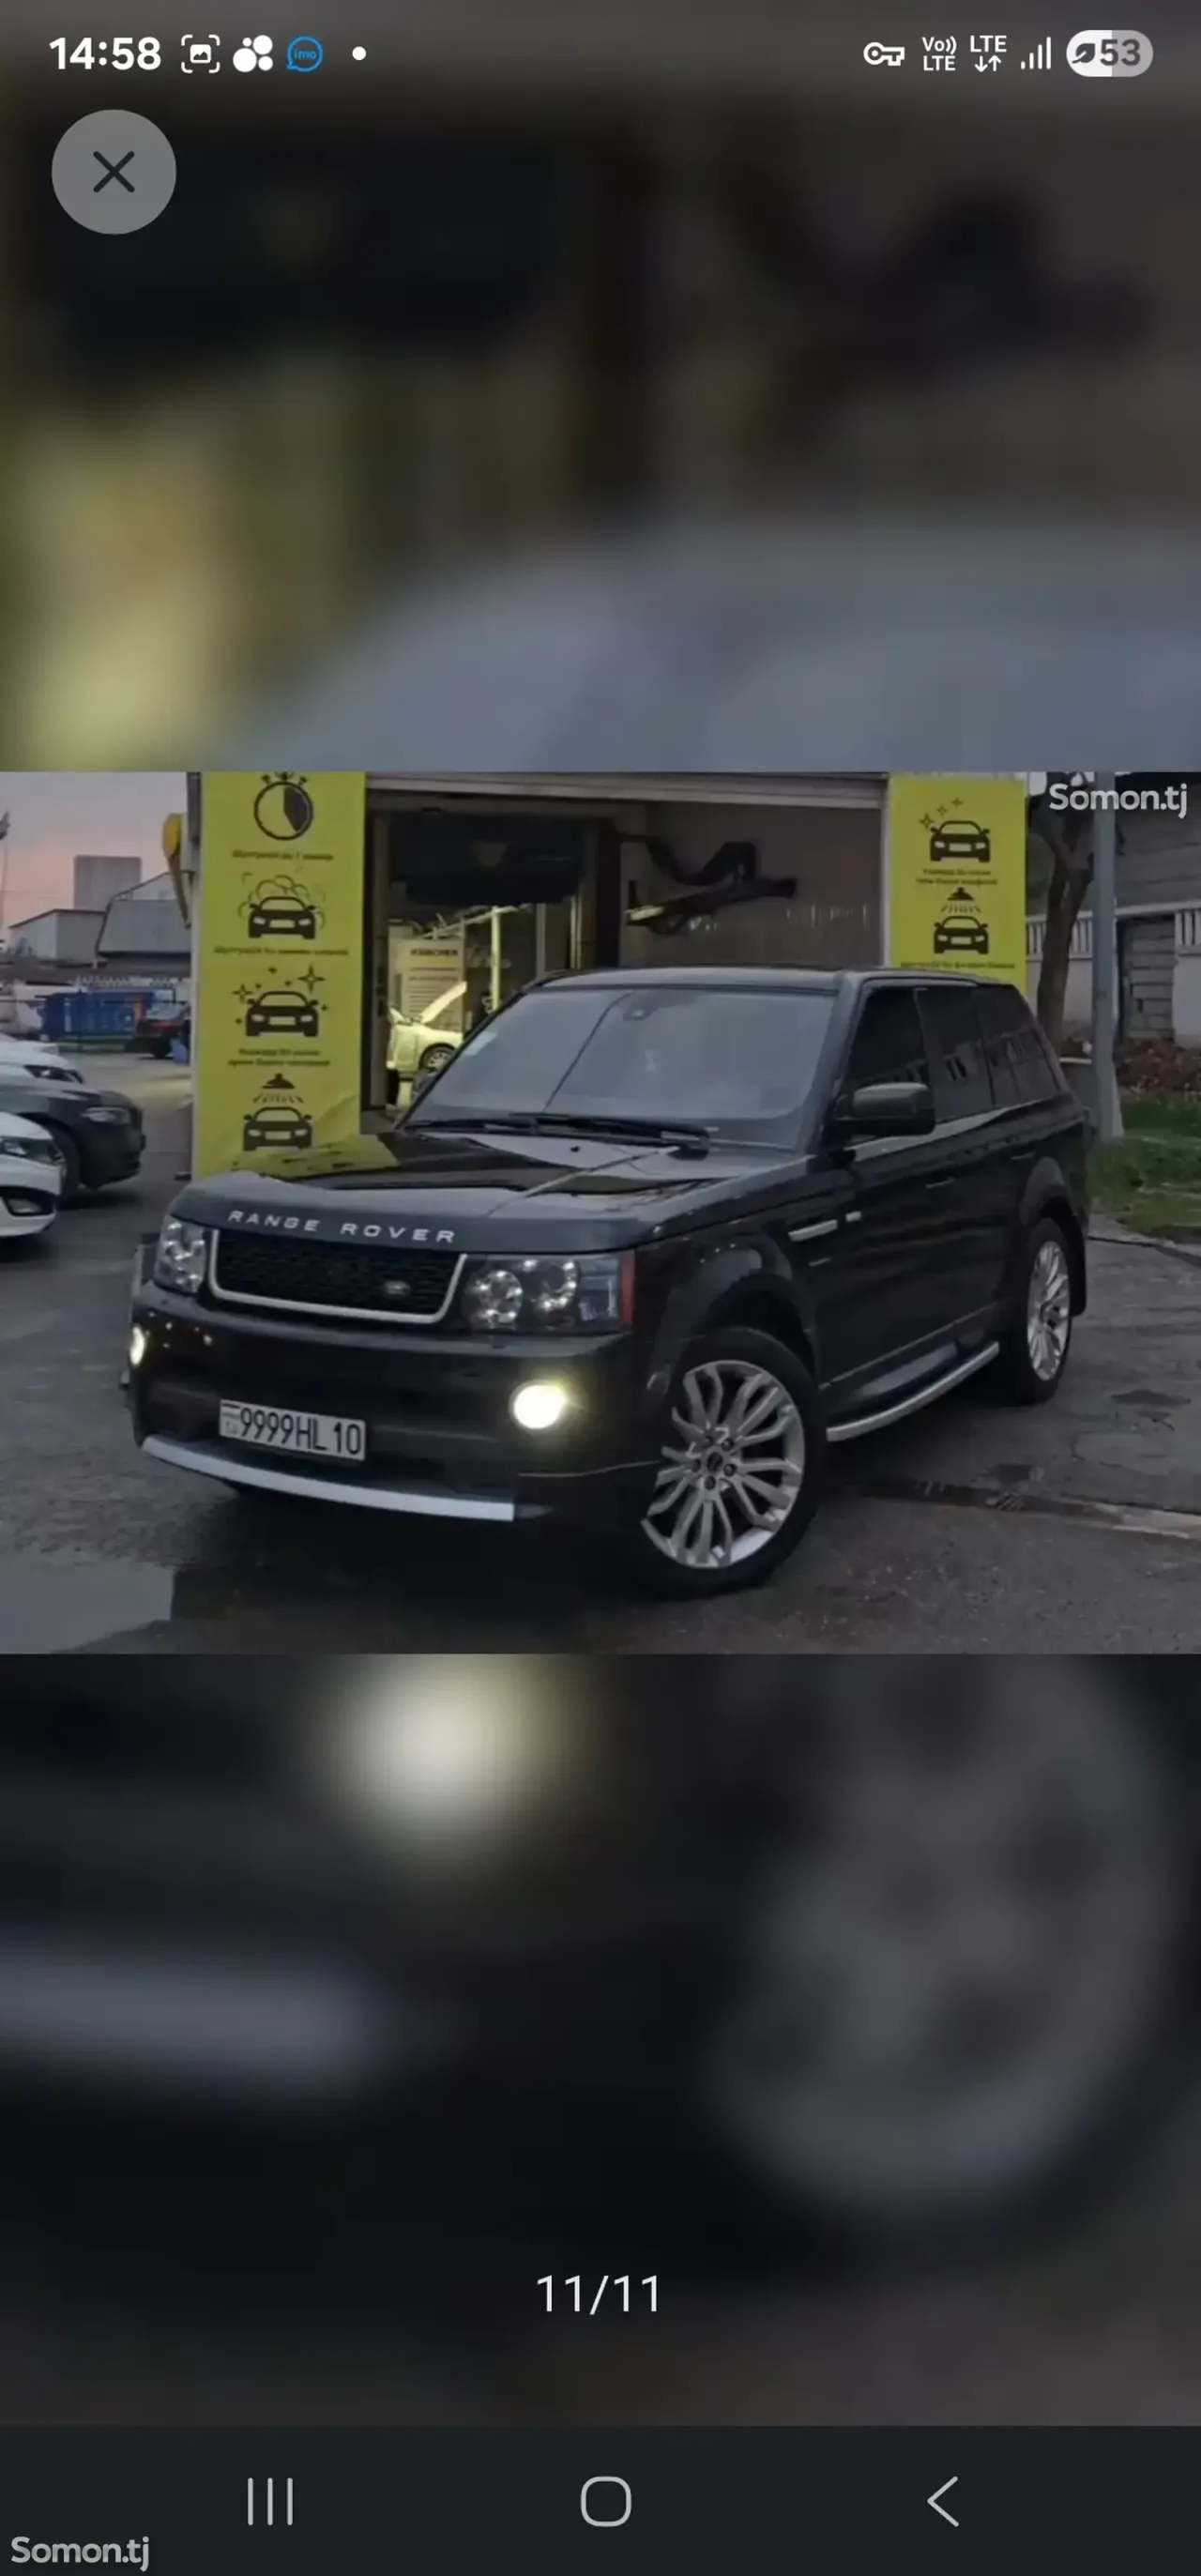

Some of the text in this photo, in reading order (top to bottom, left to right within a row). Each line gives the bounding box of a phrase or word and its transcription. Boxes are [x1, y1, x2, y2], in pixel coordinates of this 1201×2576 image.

[227, 1210, 456, 1244] RANGE ROVER
[332, 1421, 362, 1455] 10
